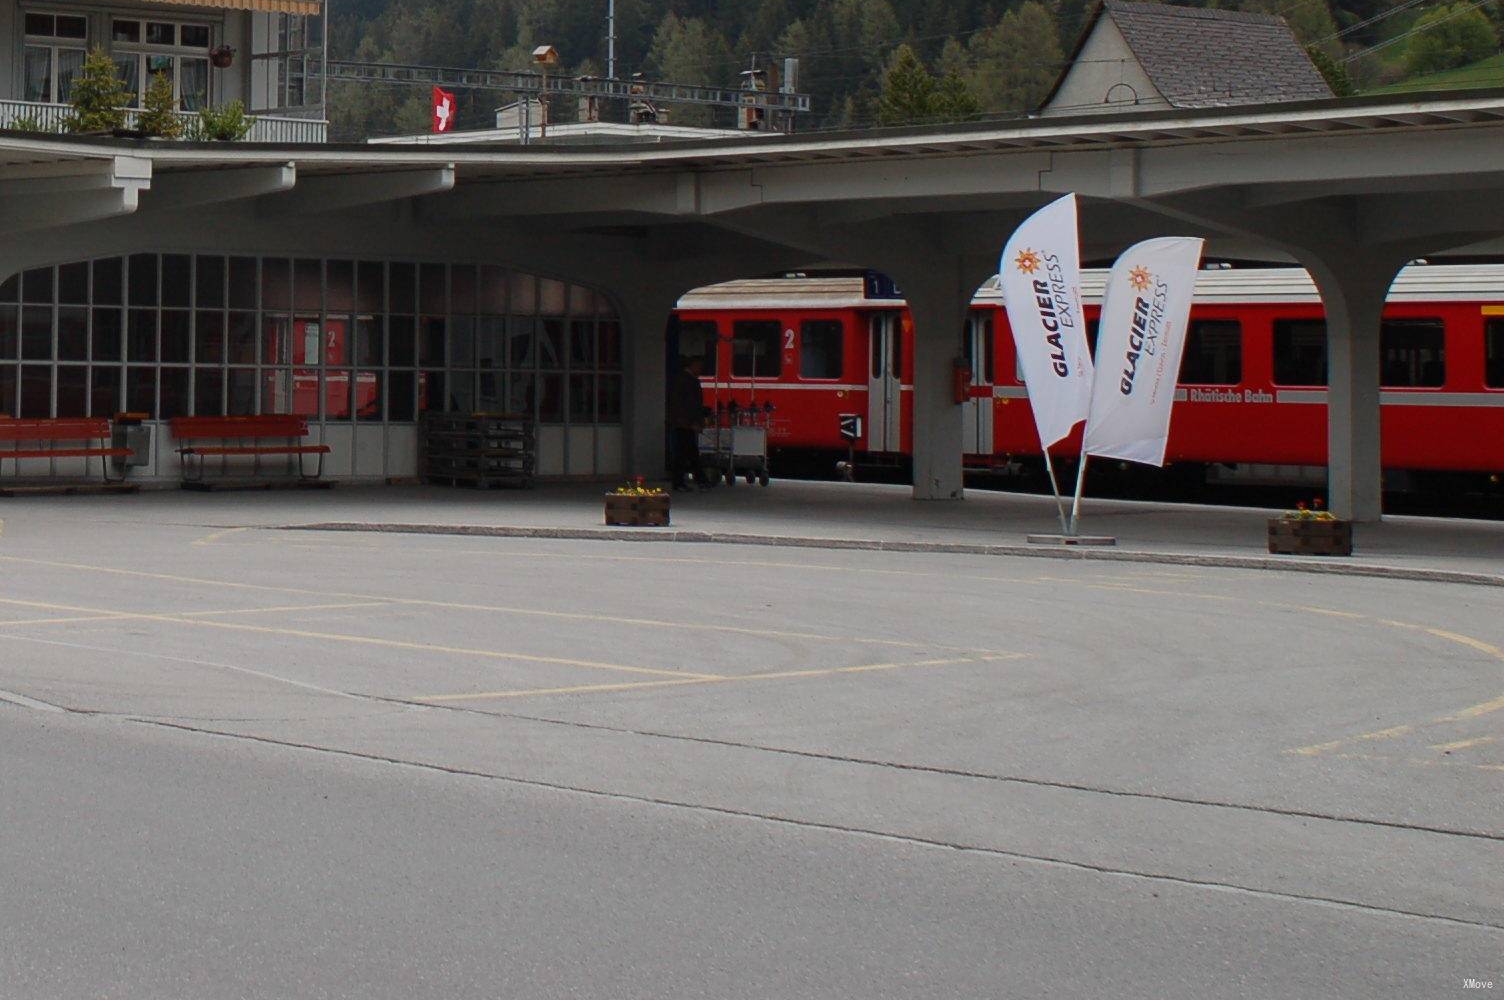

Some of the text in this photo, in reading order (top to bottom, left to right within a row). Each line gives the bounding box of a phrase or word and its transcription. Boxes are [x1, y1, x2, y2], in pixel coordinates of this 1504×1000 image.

[1032, 279, 1068, 378] GLACIER
[1044, 254, 1074, 328] EXPRESS
[1146, 280, 1168, 357] EXPRESS
[784, 328, 795, 348] 2
[1120, 296, 1150, 396] GLACIER
[1190, 388, 1273, 403] Rhätische Bahn
